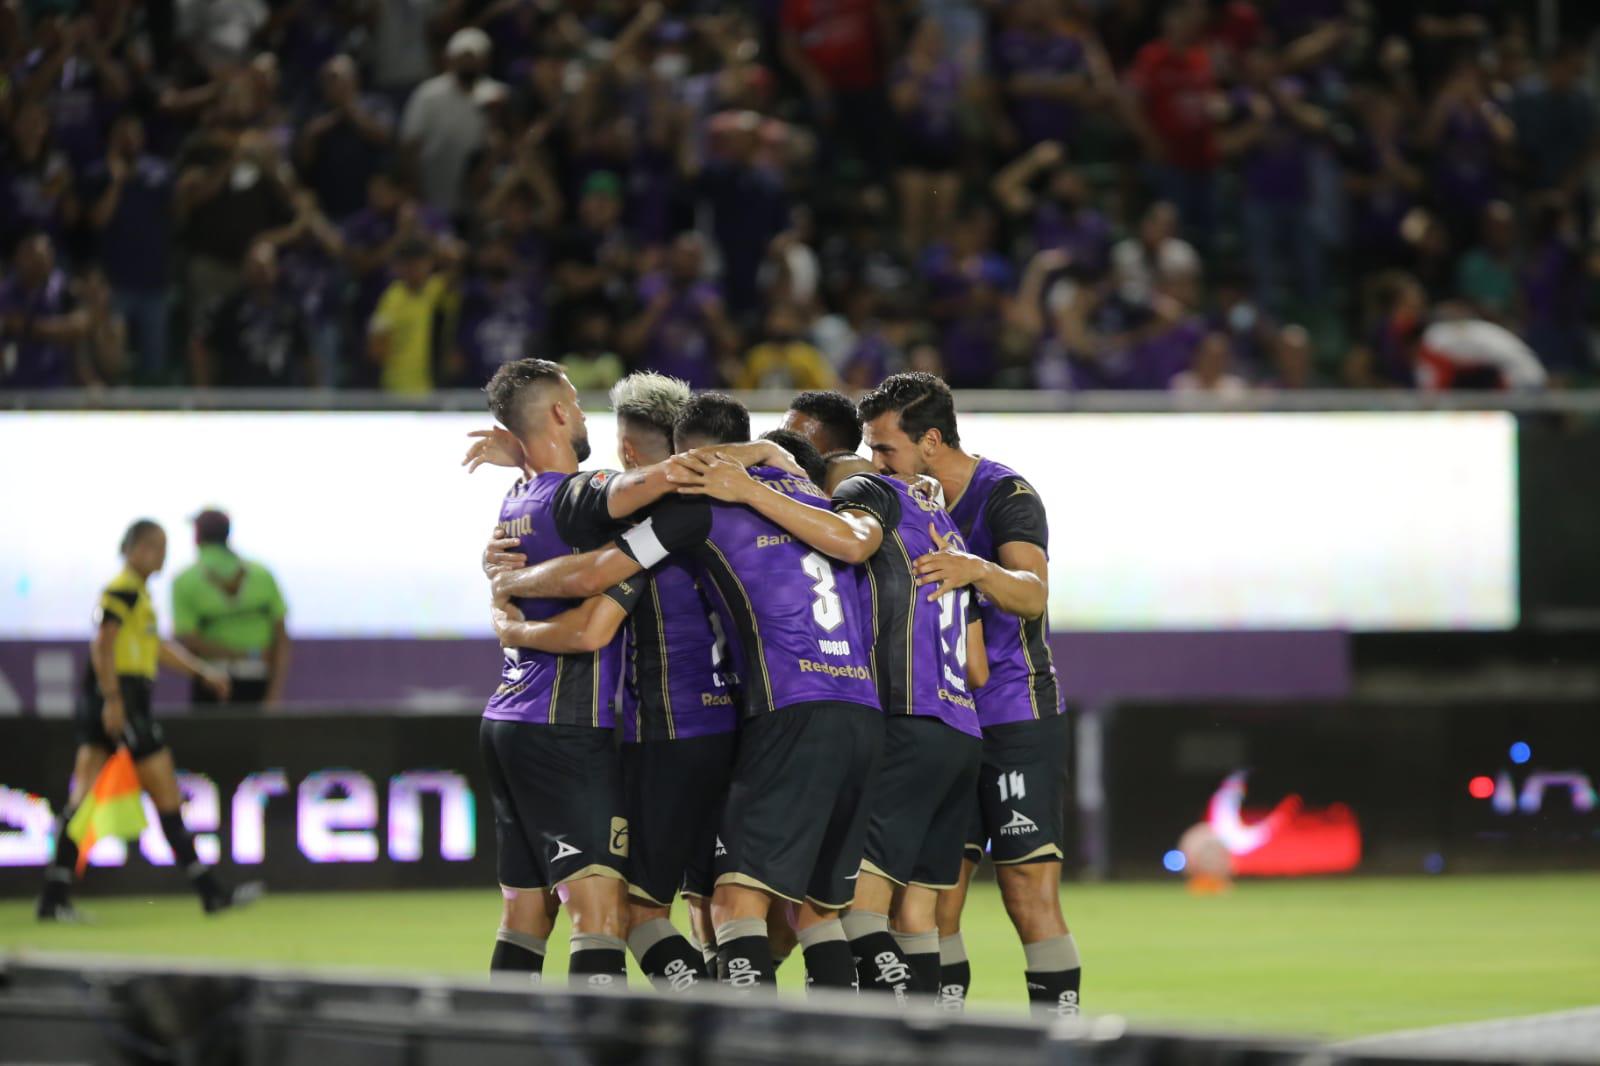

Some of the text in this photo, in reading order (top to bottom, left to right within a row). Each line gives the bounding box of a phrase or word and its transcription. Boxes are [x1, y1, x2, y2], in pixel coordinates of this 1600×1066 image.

[801, 552, 843, 632] 3
[997, 770, 1026, 803] 14
[1000, 824, 1039, 837] PIRMA
